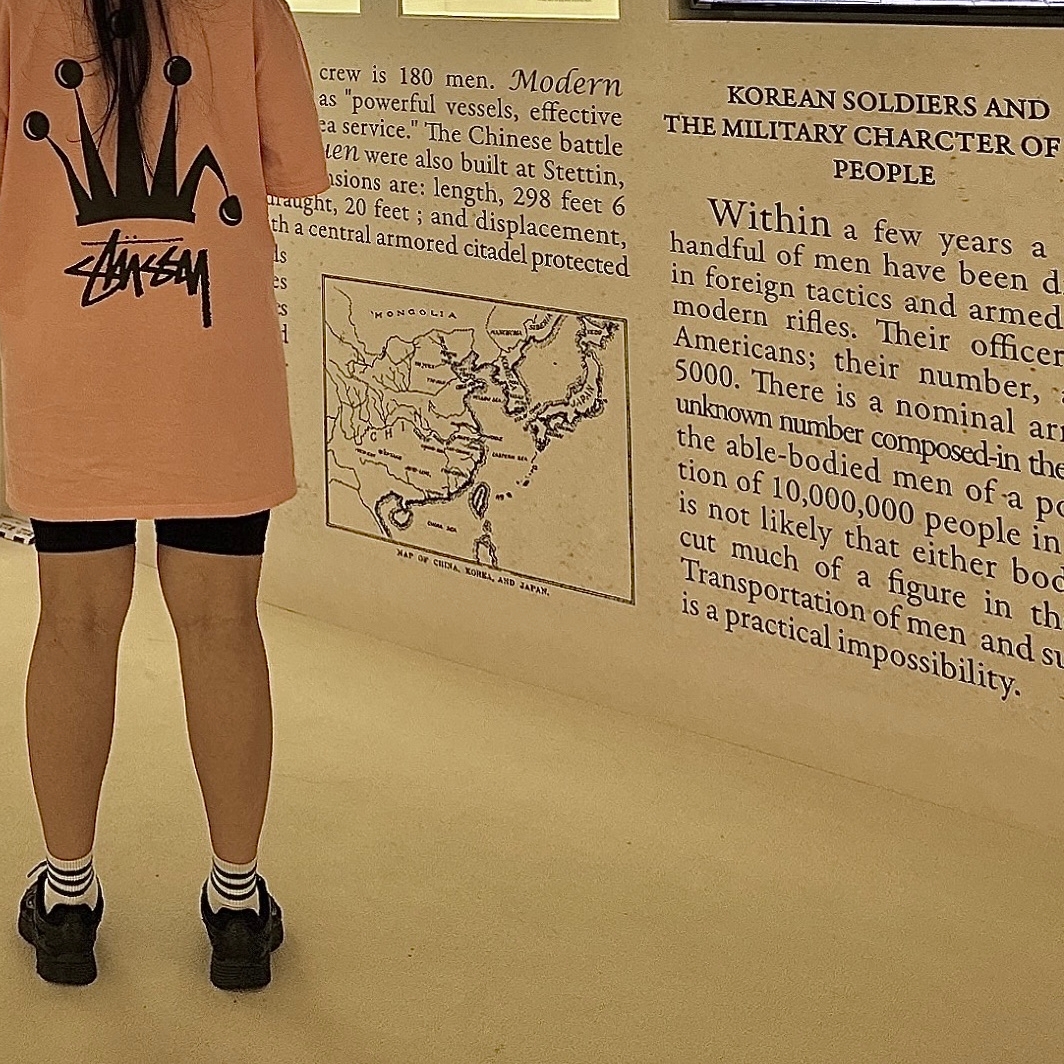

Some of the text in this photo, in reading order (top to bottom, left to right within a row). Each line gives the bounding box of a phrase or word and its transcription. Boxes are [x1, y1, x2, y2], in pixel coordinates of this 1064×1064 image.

[319, 64, 624, 97] crew is 180 men. Modern
[318, 88, 623, 127] as "powerful vessels, effective
[726, 85, 1051, 120] KOREAN SOLDIERS AND
[663, 113, 1061, 160] THE MILITARY CHARCTER OF
[832, 159, 936, 186] PEOPLE
[706, 197, 1048, 259] Within a few years a
[373, 307, 458, 320] MONGOLIA
[570, 383, 595, 408] JAPAN
[497, 576, 516, 587] AND
[681, 590, 1021, 702] is a practical impossibility.
